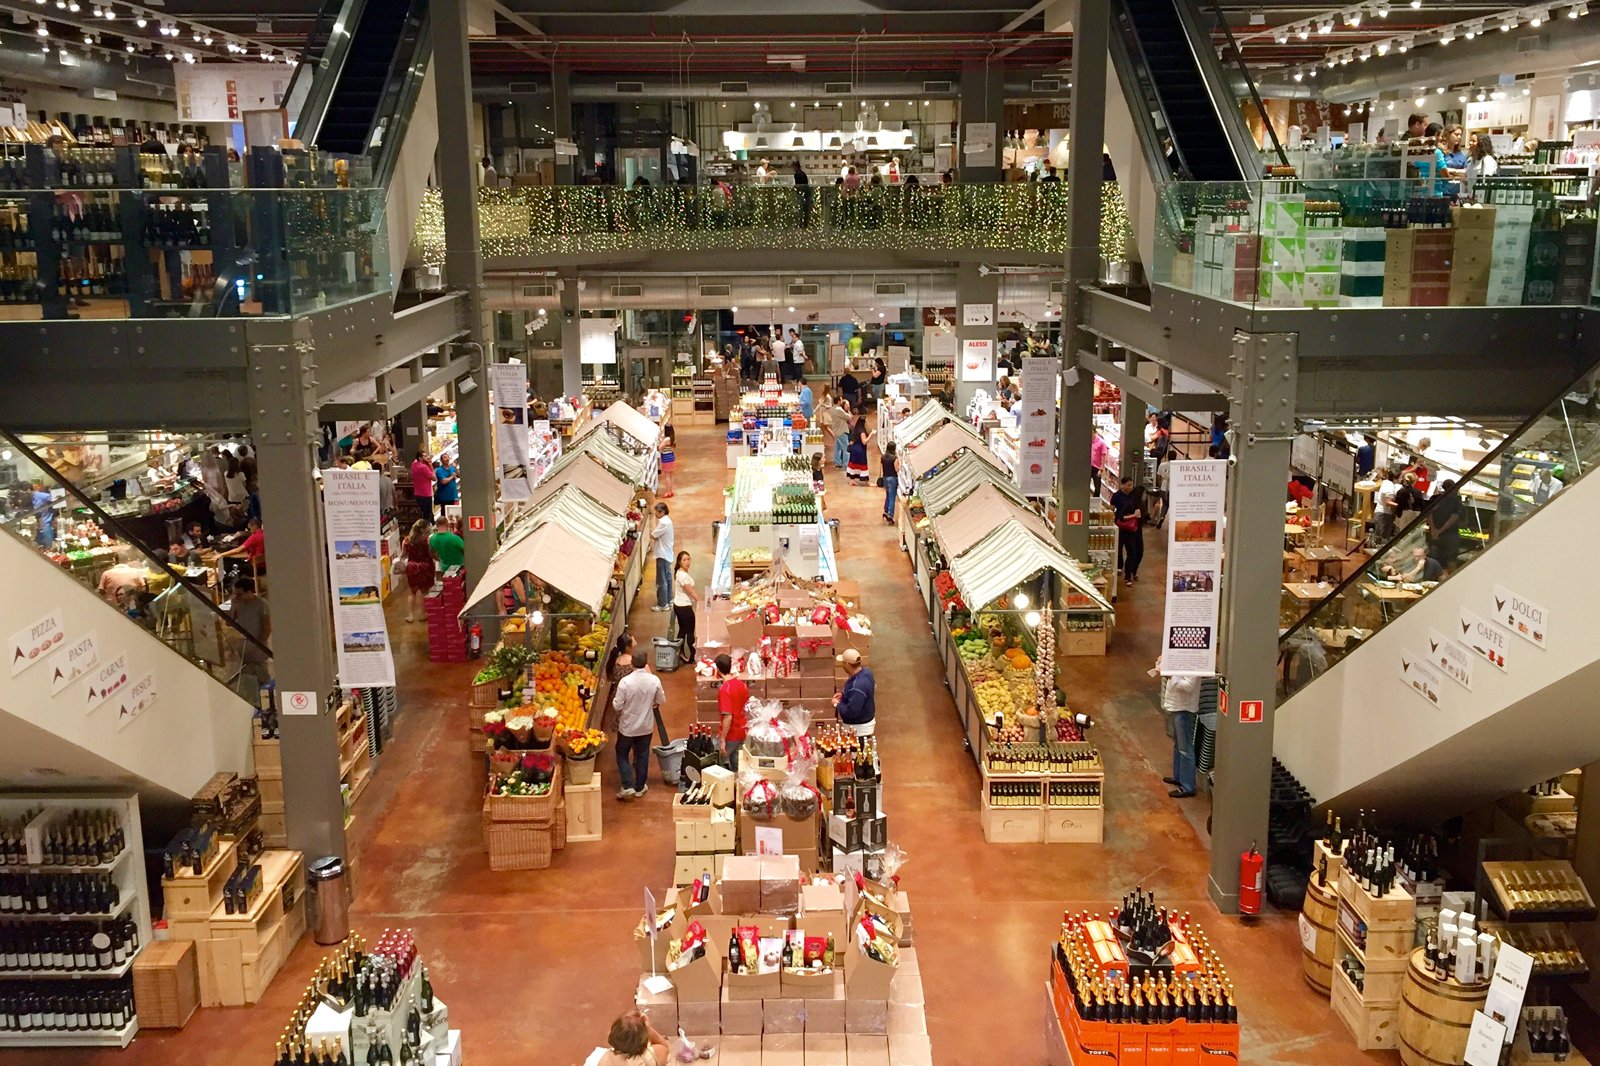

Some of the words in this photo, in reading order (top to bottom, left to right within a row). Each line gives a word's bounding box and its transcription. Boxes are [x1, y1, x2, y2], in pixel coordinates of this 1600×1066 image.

[1053, 104, 1071, 119] ROS
[1512, 597, 1542, 624] DOLCI
[31, 617, 57, 641] PIZZA
[69, 638, 93, 662] PASTA
[100, 656, 124, 682] CARNE
[131, 674, 153, 699] PESCE
